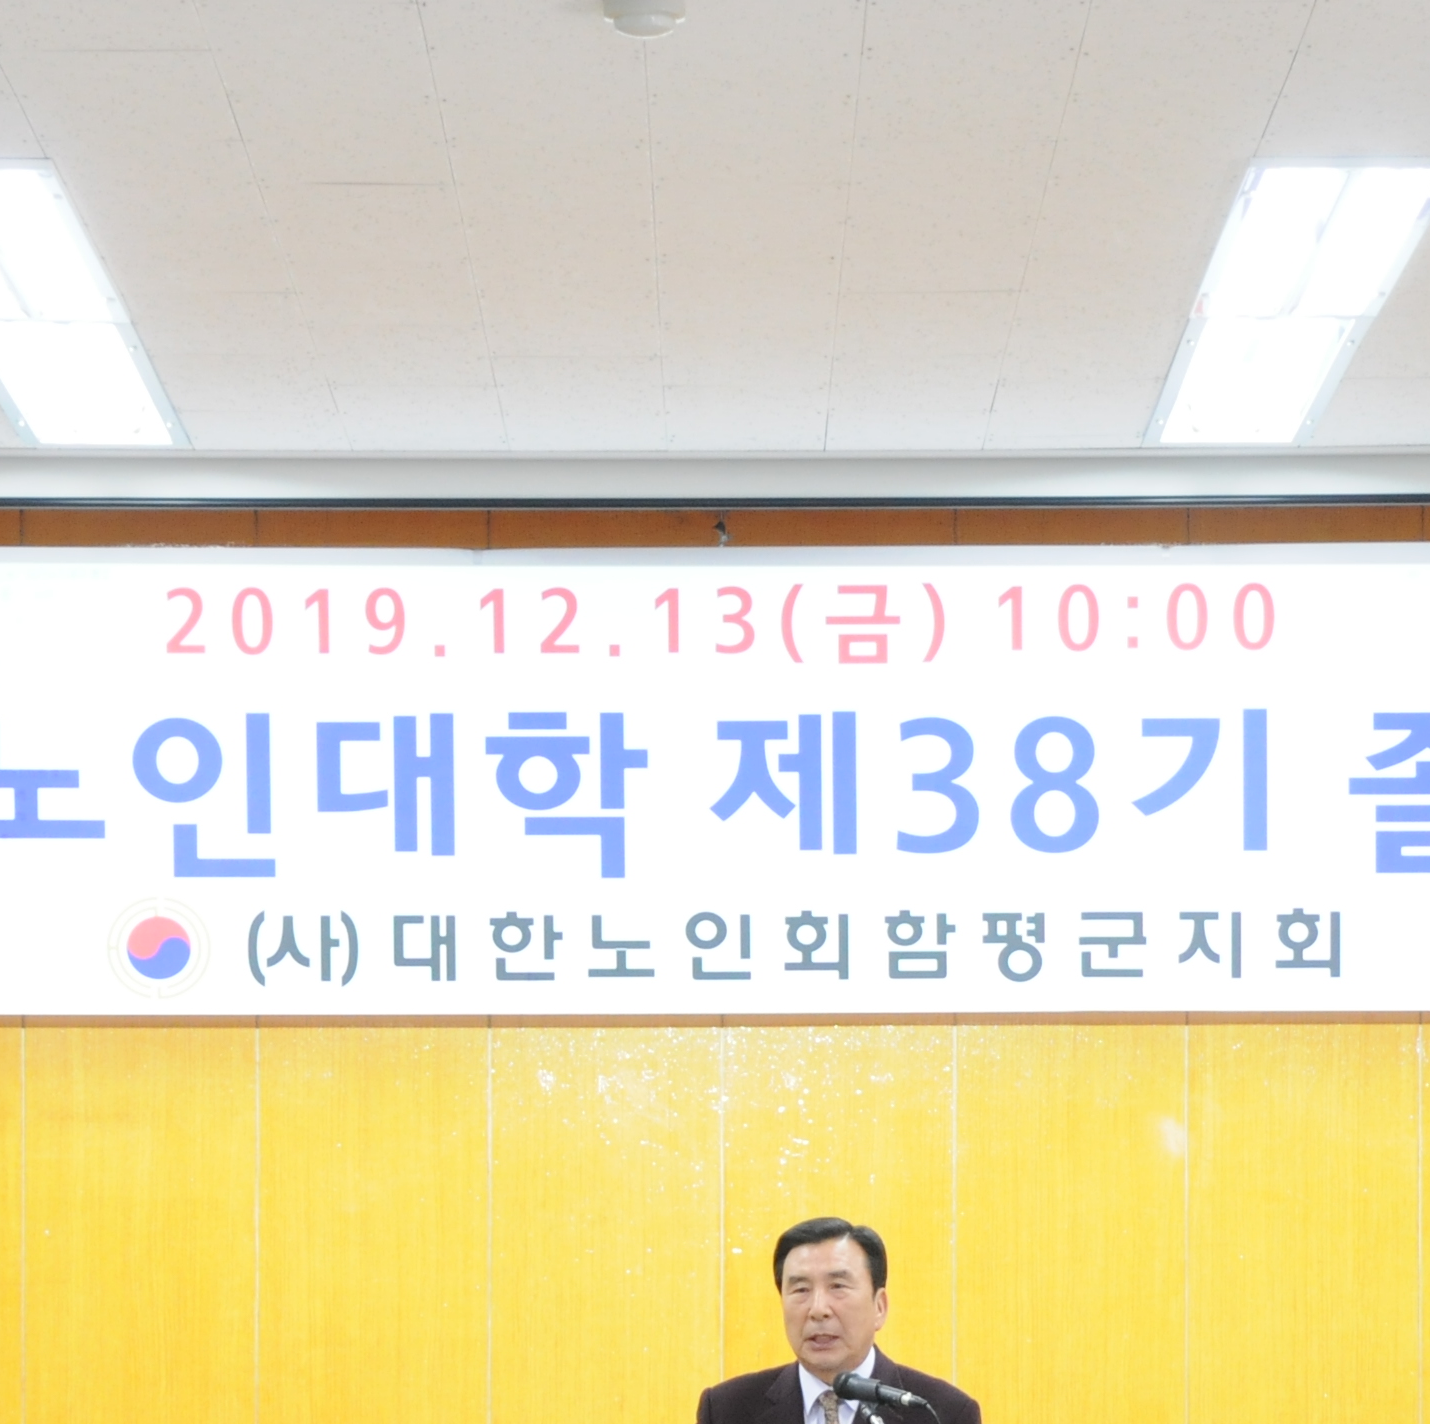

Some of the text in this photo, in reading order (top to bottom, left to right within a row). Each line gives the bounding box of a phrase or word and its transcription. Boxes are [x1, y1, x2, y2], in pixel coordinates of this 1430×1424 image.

[165, 581, 1277, 664] 2019.12.13(금) 10:00
[709, 707, 1270, 856] 제38기
